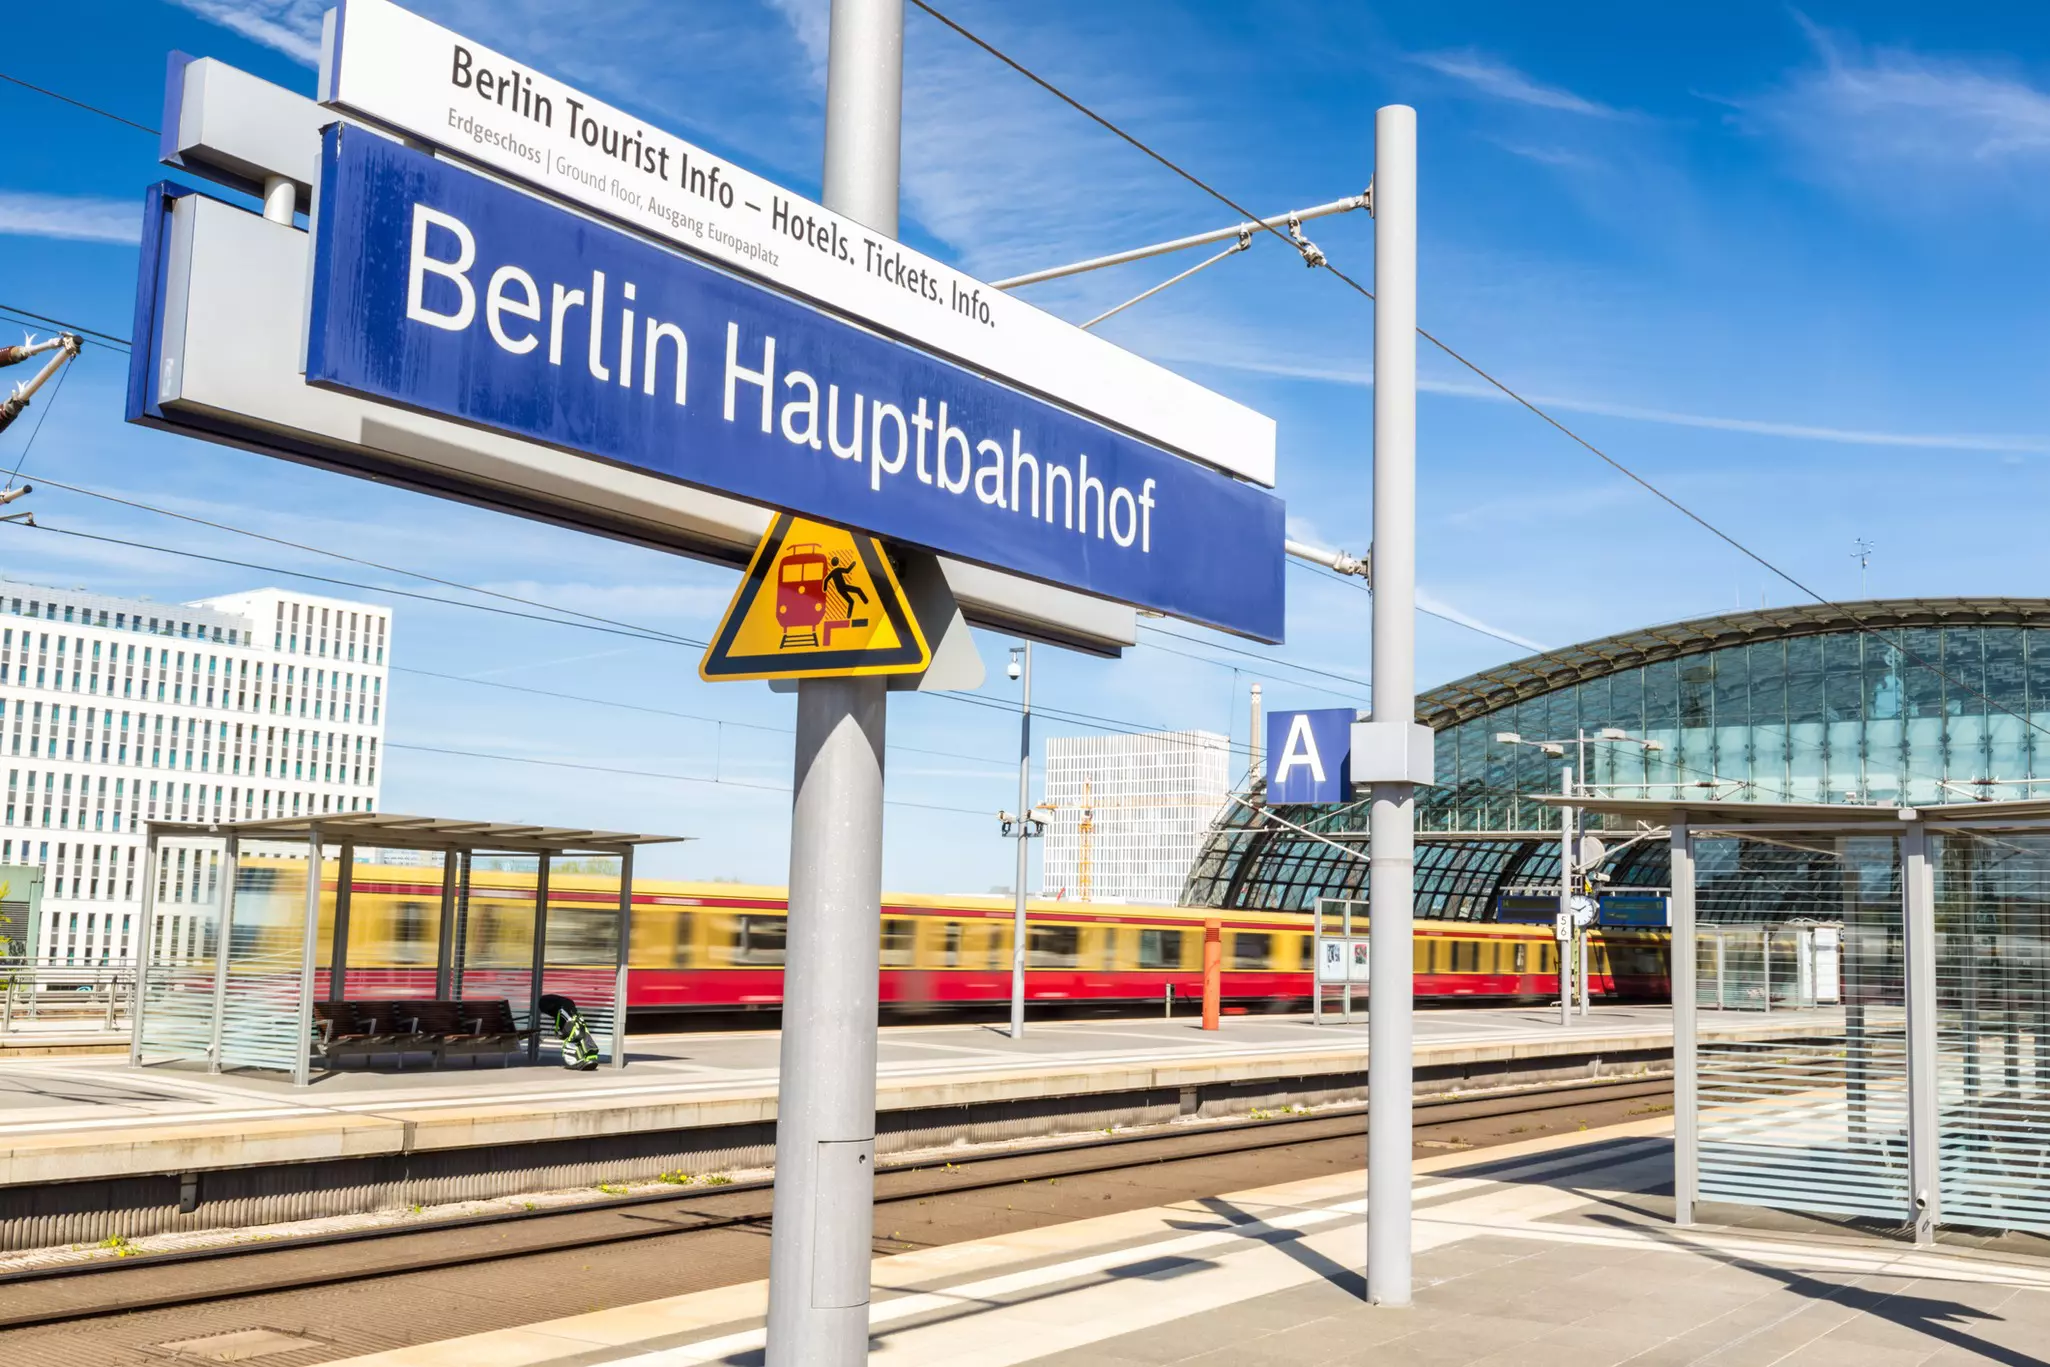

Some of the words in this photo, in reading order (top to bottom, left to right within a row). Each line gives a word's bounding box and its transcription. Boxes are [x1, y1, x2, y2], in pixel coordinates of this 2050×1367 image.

[447, 107, 542, 165] Erdgeschoss
[556, 156, 606, 193] Ground
[611, 178, 643, 211] floor,
[647, 196, 704, 238] Ausgang
[708, 223, 780, 267] Europaplatz
[451, 45, 553, 128] Berlin
[565, 98, 670, 182] Tourist
[680, 153, 734, 209] Info
[772, 196, 855, 266] Hotels.
[864, 239, 943, 305] Tickets.
[952, 280, 995, 328] Info.
[406, 203, 689, 406] Berlin
[723, 322, 1156, 553] Hauptbahnhof
[1274, 713, 1327, 783] A
[1560, 915, 1567, 926] 5
[1560, 926, 1567, 937] 6
